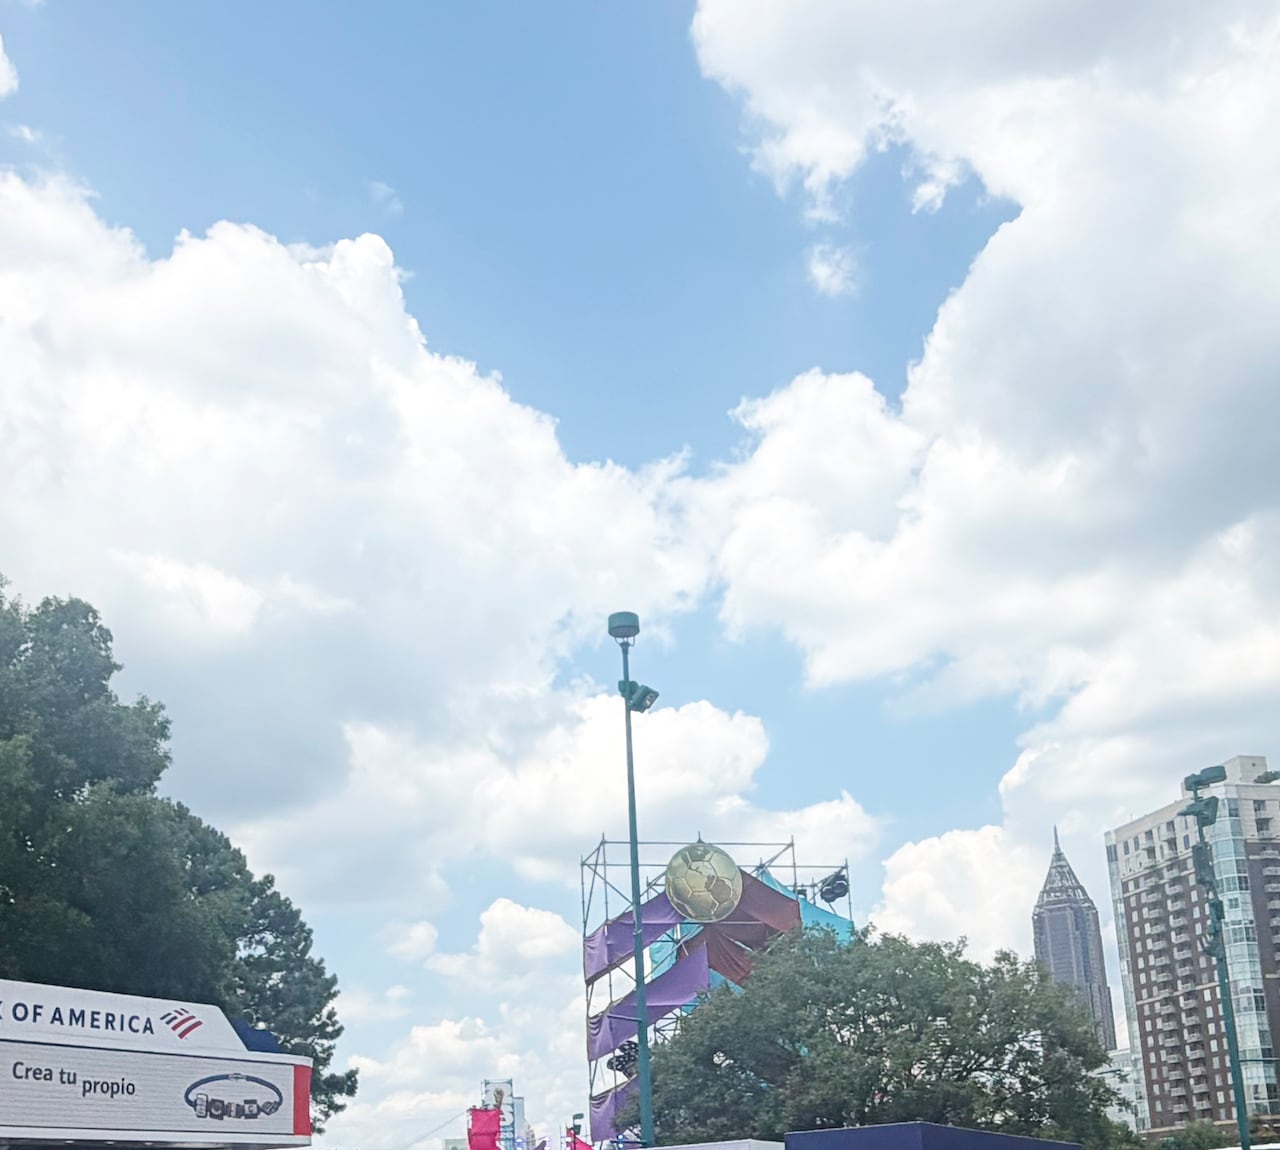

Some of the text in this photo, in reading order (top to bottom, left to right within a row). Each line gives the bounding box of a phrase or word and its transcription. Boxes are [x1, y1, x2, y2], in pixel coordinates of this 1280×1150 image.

[12, 1001, 44, 1024] OF
[50, 1006, 155, 1035] AMERICA
[12, 1061, 136, 1098] Crea tu propio
